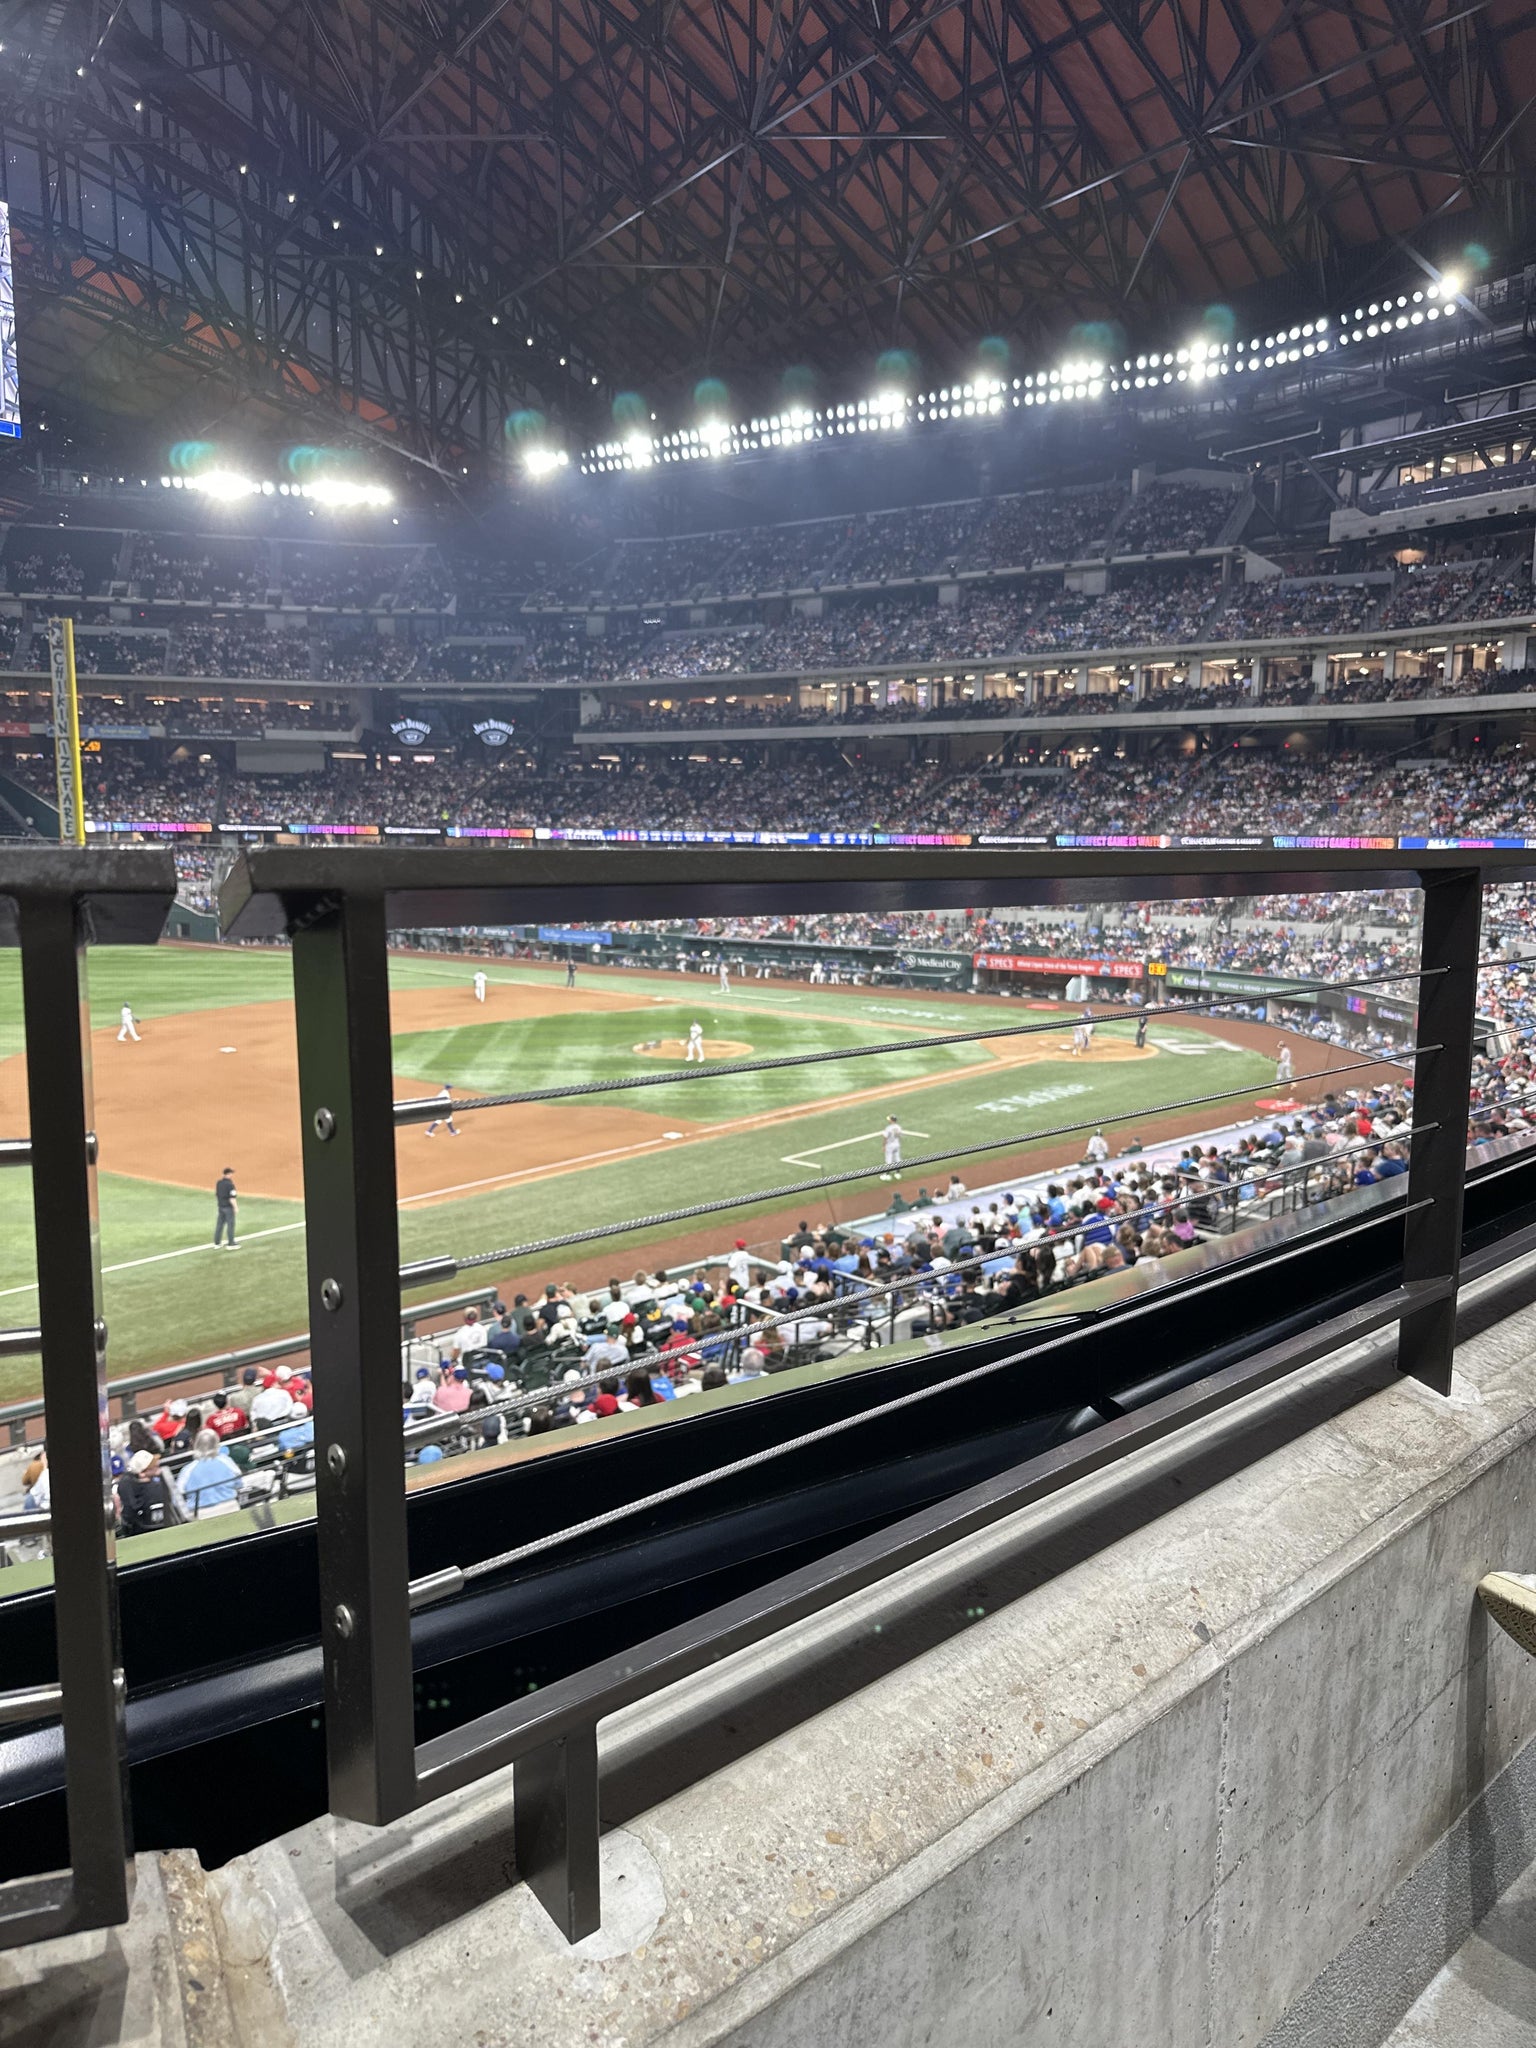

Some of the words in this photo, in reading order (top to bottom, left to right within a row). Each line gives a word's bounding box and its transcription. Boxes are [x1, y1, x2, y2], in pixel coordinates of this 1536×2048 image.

[60, 738, 71, 769] IZ
[1055, 834, 1075, 846] YOUR
[1075, 835, 1107, 847] PERFECT
[1107, 836, 1128, 847] GAME
[1273, 836, 1296, 848] YOUR
[1296, 837, 1329, 848] PERFECT
[1329, 838, 1350, 848] GAME
[1350, 838, 1360, 848] IS
[1360, 838, 1395, 849] WAITING
[917, 957, 946, 969] Medical
[945, 958, 962, 971] City
[989, 957, 1014, 969] SPEC'S
[1113, 964, 1140, 976] SPEC'S
